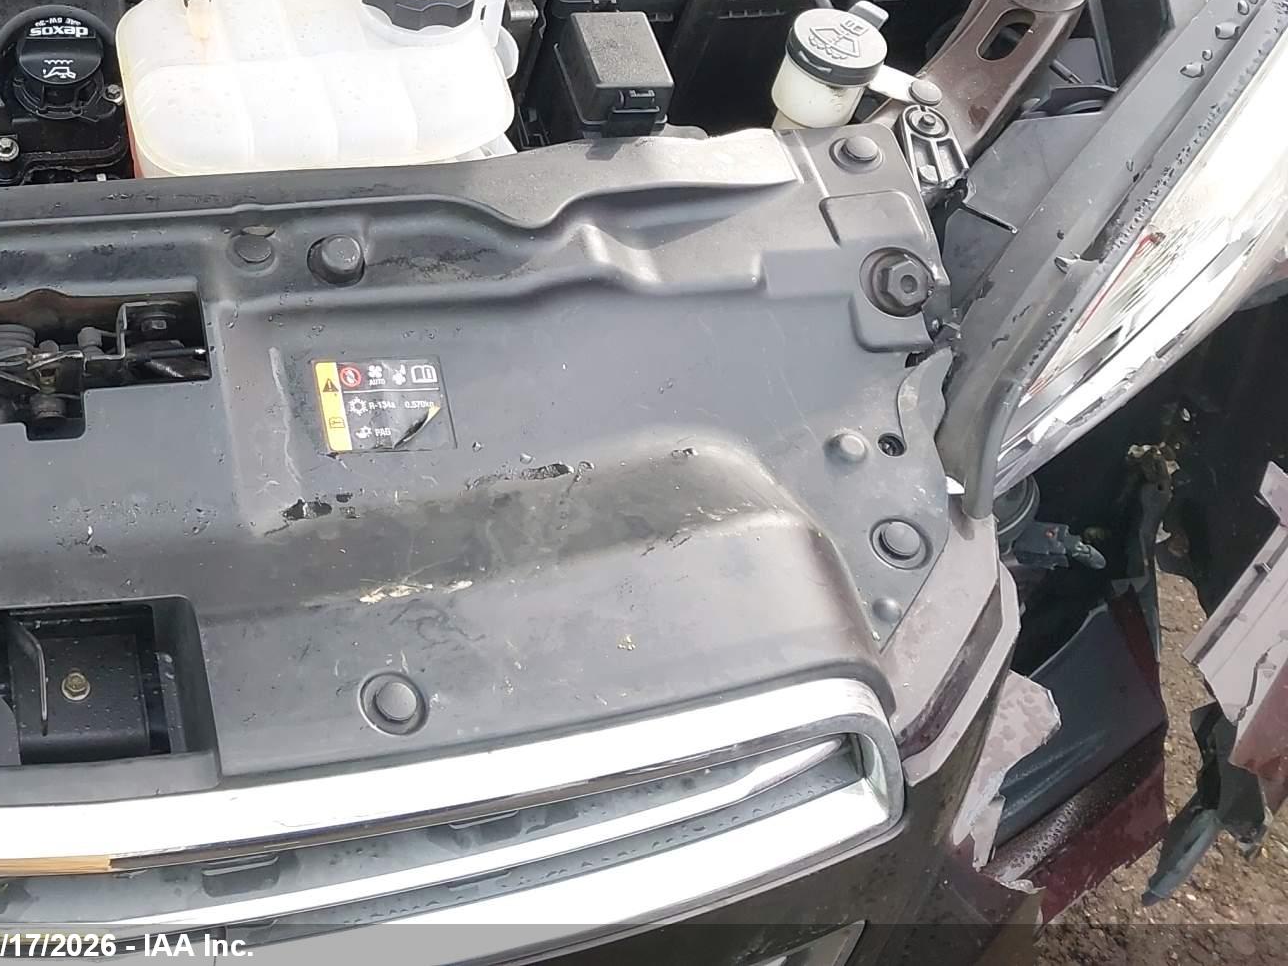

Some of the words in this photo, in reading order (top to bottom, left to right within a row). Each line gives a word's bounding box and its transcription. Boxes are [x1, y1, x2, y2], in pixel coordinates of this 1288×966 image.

[28, 25, 89, 38] dexos
[368, 378, 386, 387] AUTO
[368, 400, 396, 410] R-134a
